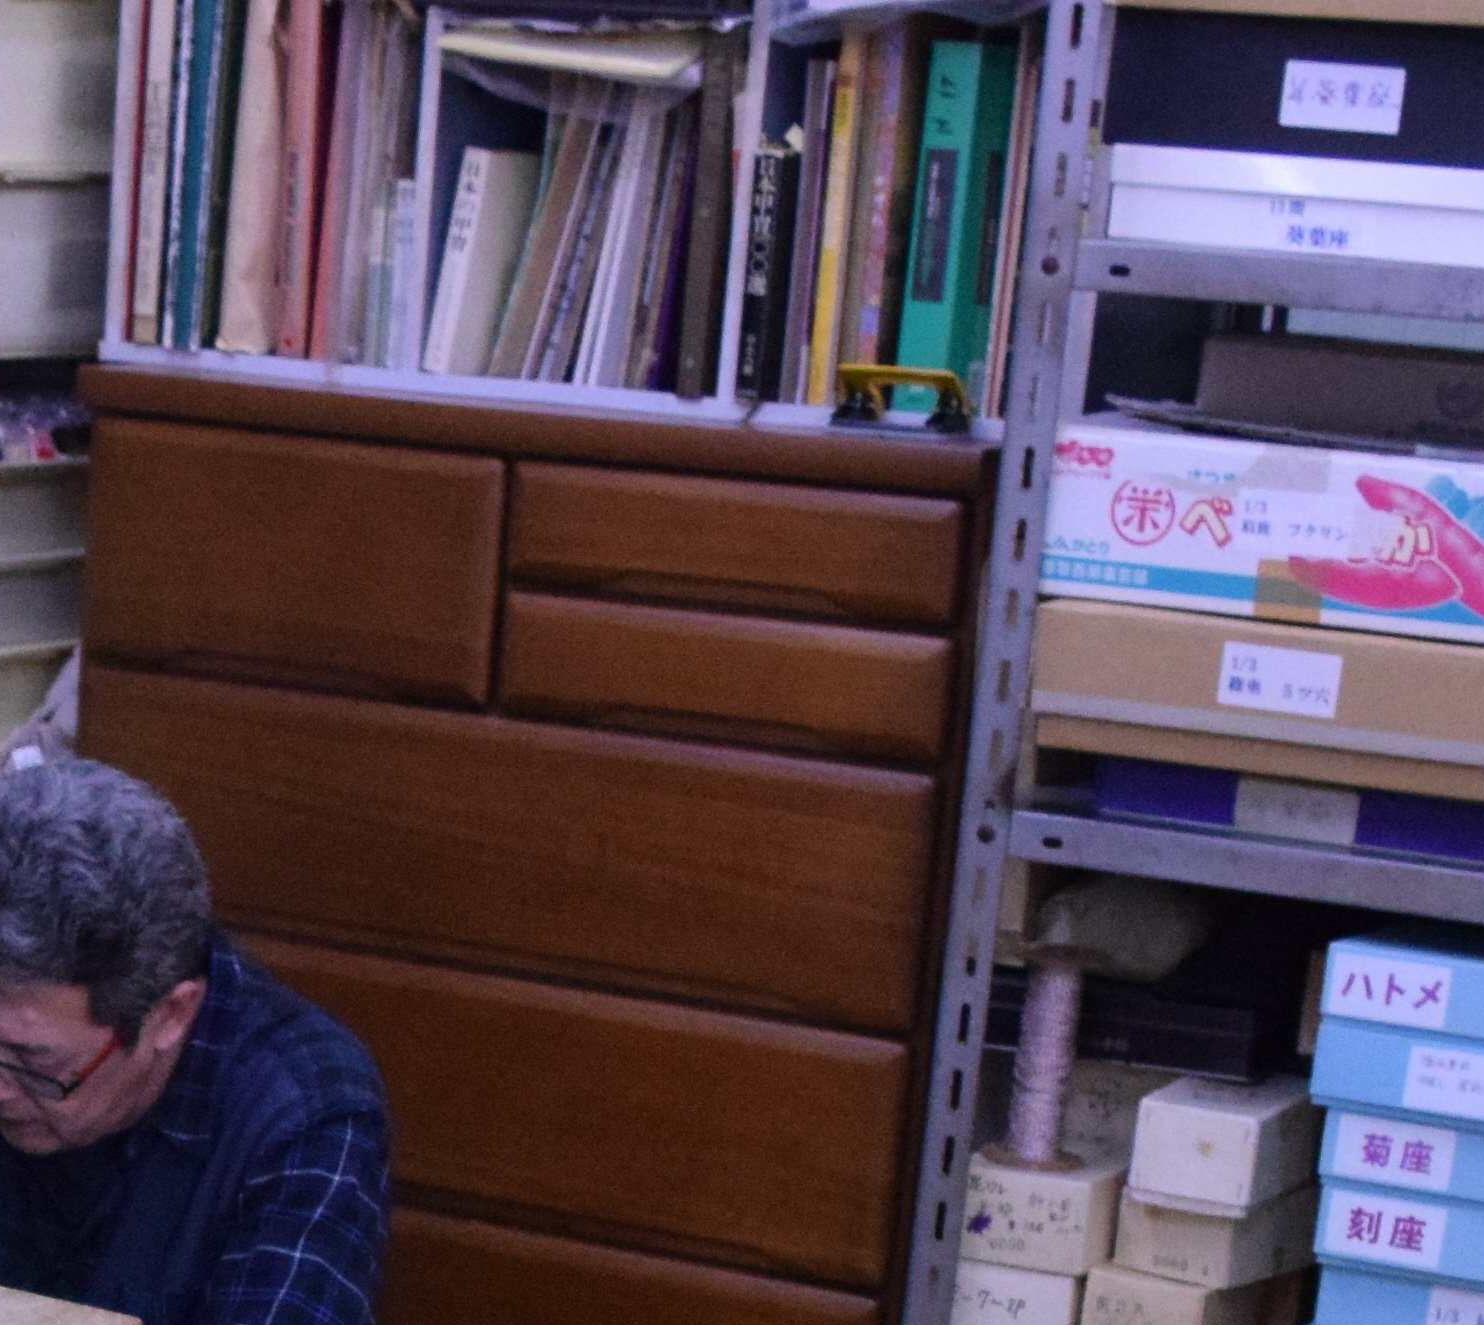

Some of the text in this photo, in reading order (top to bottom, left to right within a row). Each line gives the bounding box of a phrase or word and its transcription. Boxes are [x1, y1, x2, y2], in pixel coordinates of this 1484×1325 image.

[1341, 973, 1443, 1011] ハトメ
[1361, 1132, 1435, 1176] 菊座
[1346, 1206, 1427, 1252] 刻座
